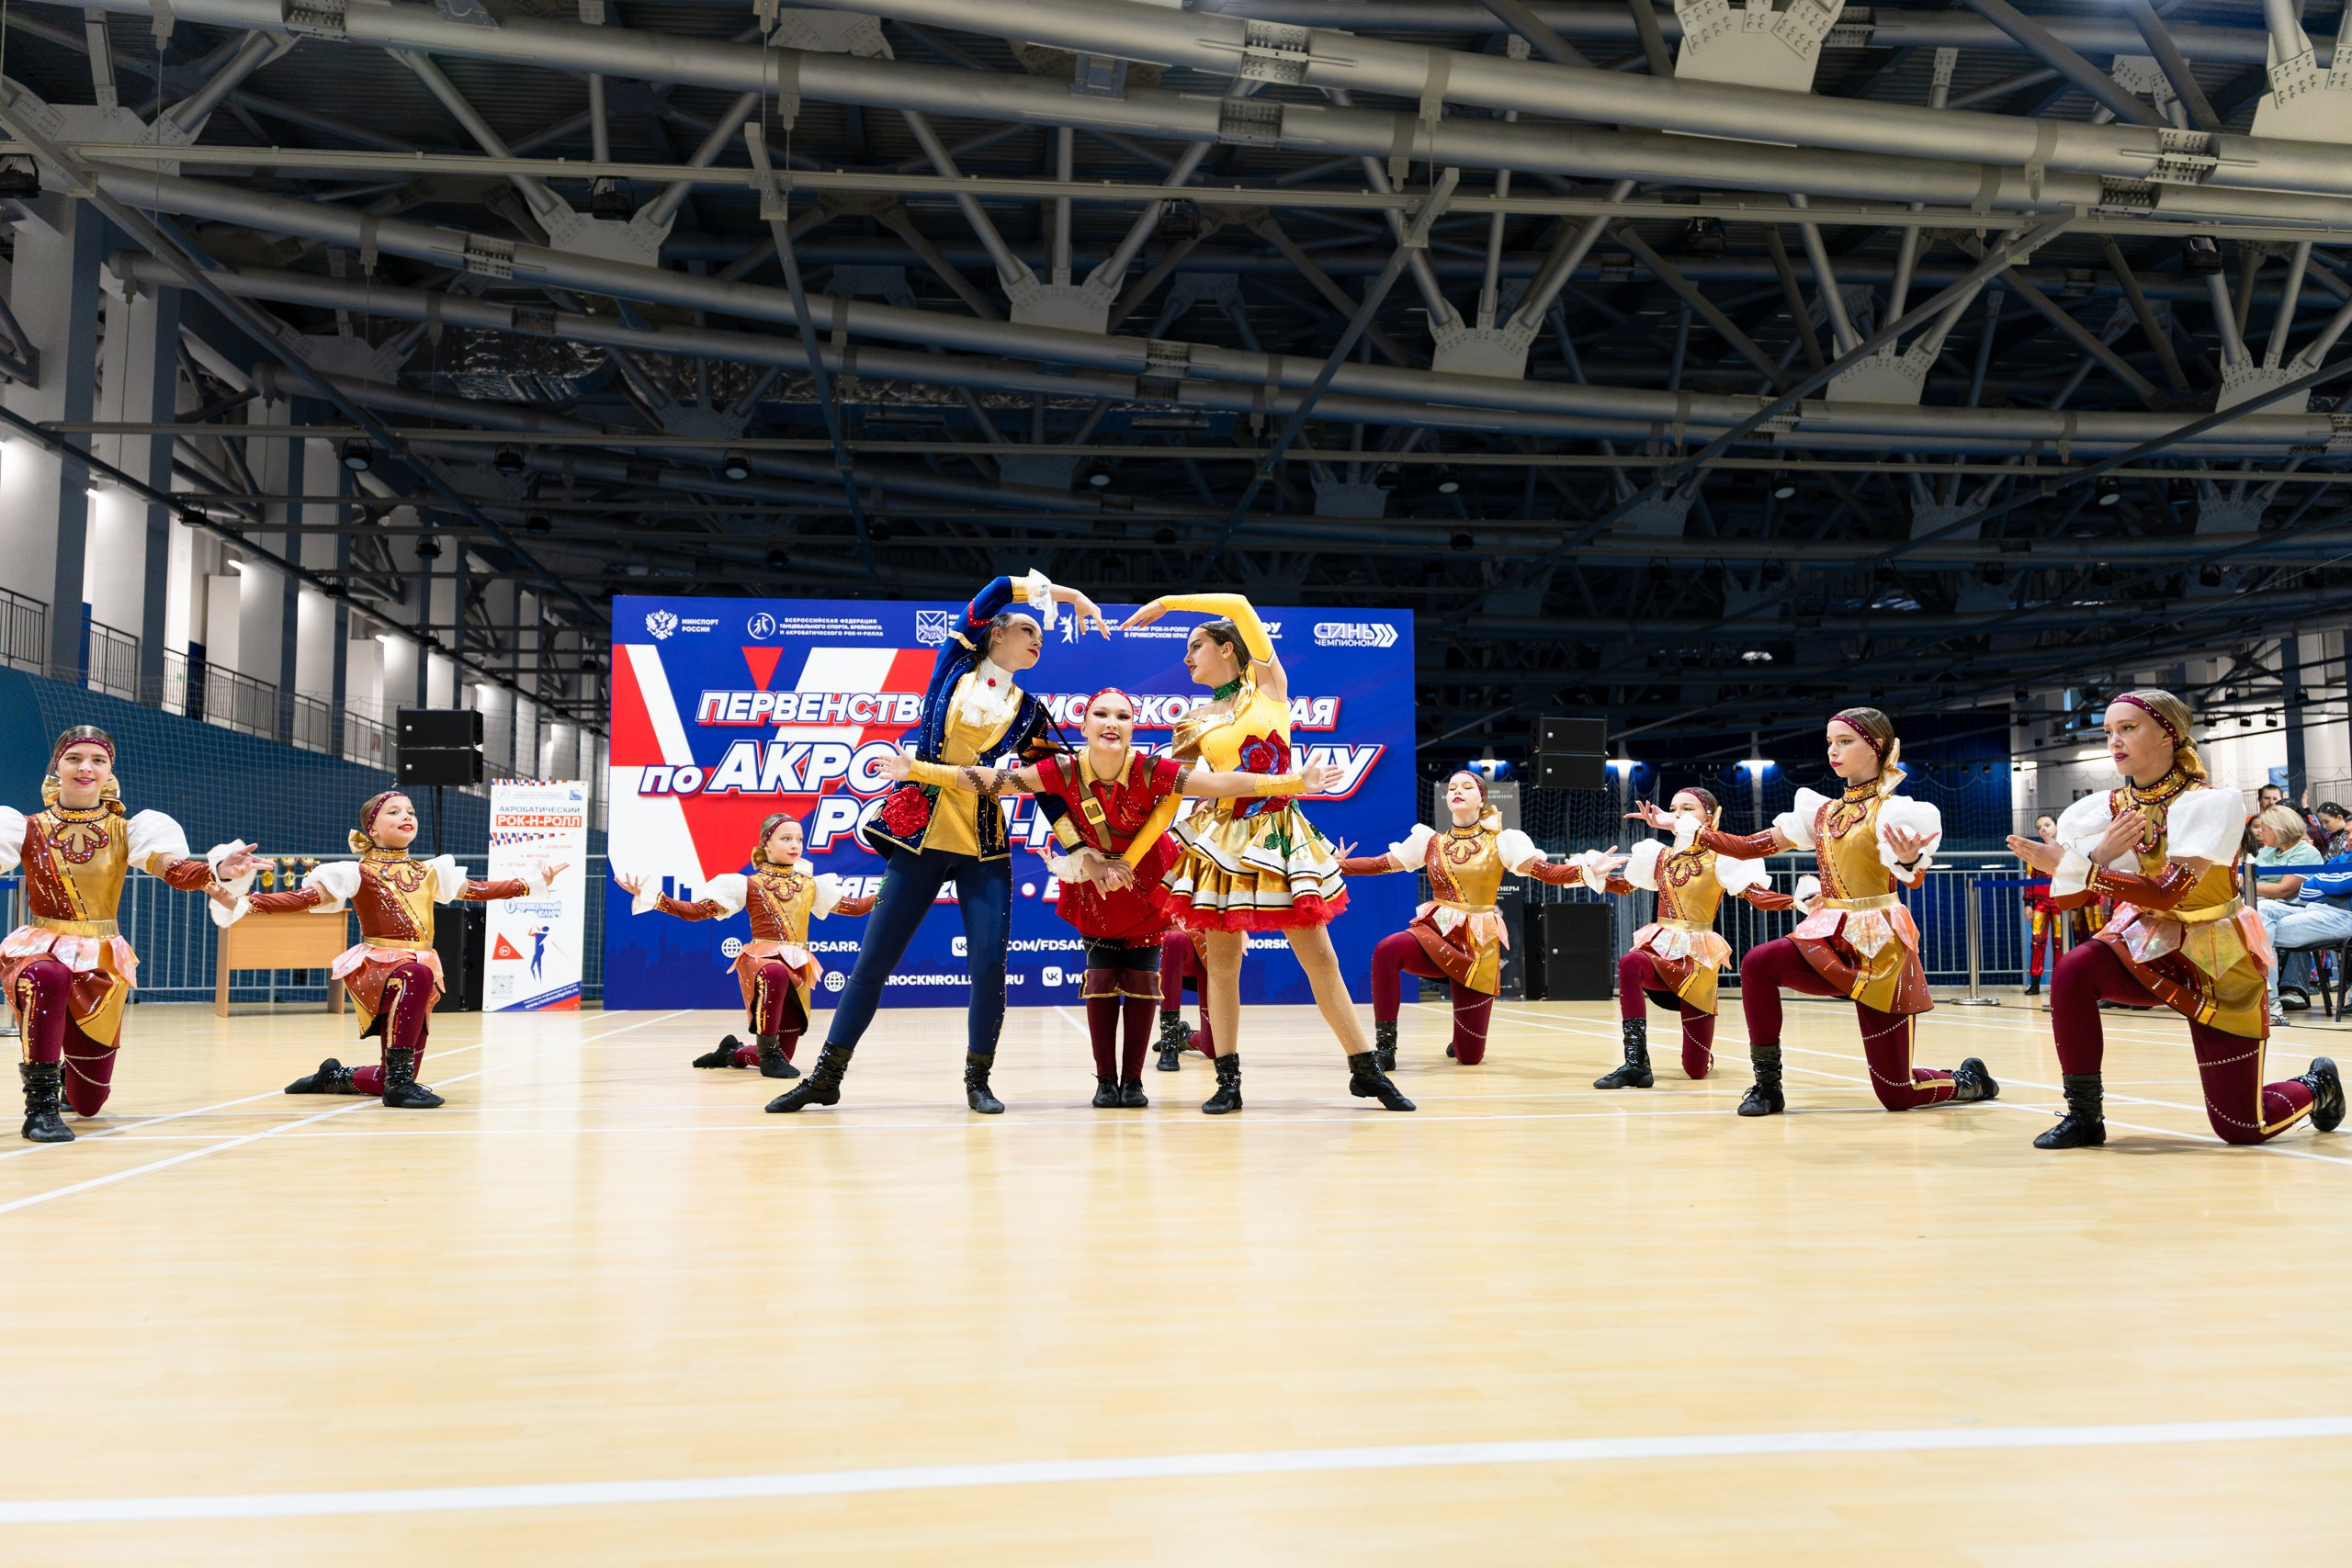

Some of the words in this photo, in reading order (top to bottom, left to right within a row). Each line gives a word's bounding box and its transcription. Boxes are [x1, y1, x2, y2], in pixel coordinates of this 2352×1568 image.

[1314, 638, 1375, 647] ЧЕМПИОНОМ
[696, 692, 925, 723] ПЕРВЕНСТВ
[497, 816, 581, 827] РОК-Н-РОЛЛ
